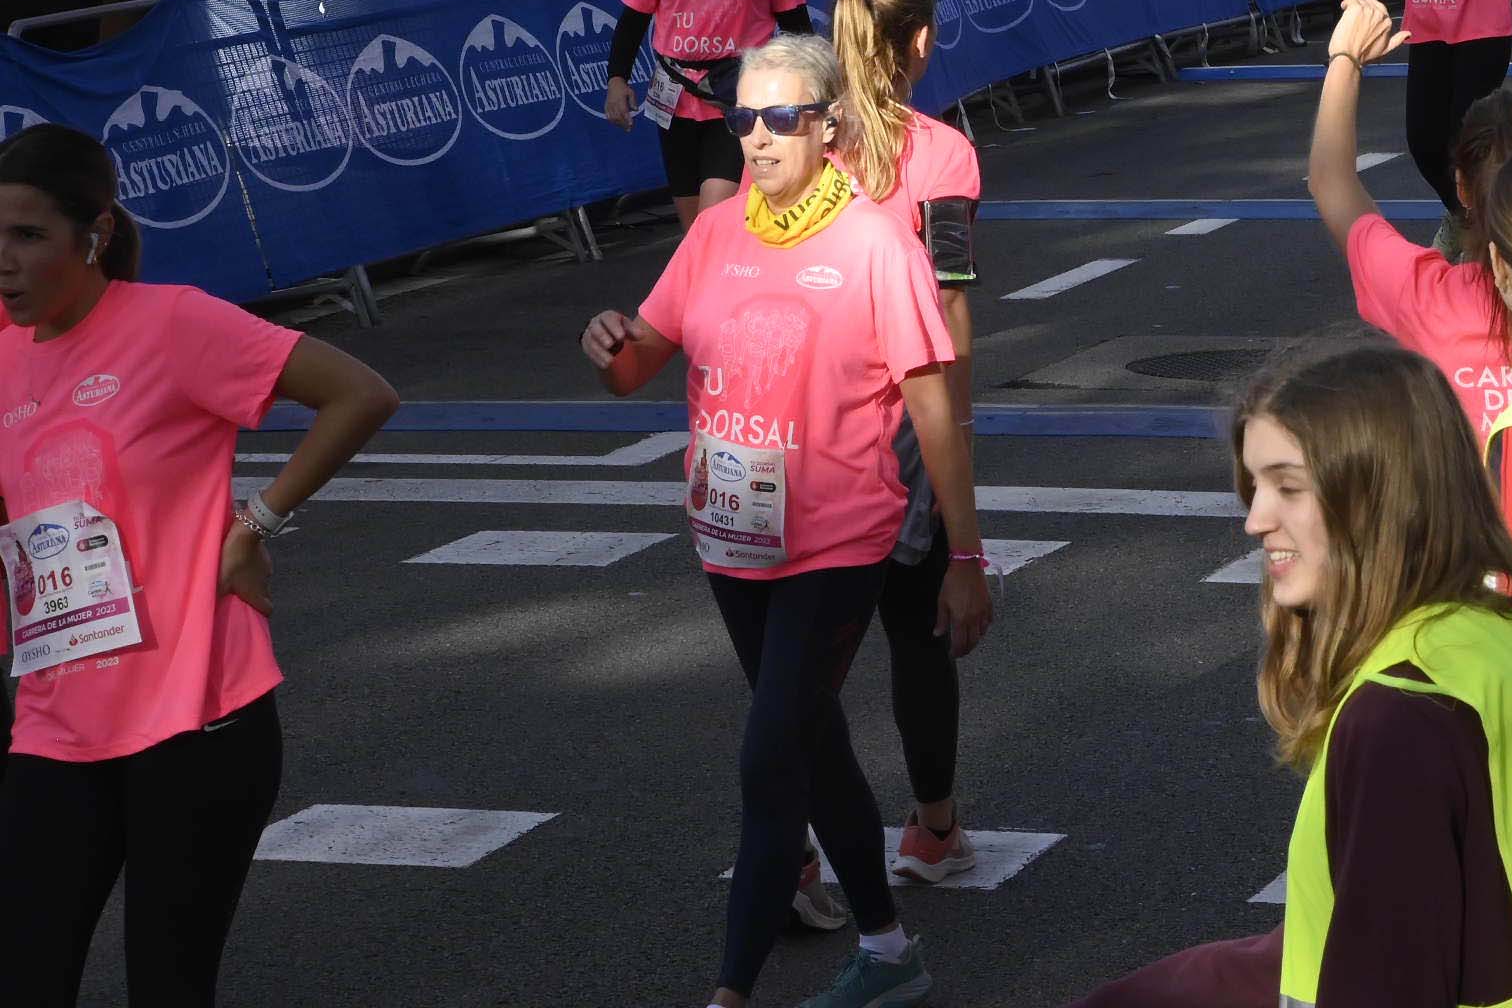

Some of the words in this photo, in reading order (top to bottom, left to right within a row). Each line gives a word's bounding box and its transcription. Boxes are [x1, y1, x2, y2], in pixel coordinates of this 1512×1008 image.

[673, 11, 694, 29] TU
[672, 35, 736, 54] DORSA
[479, 58, 511, 73] CENTRAL
[512, 54, 546, 68] LECHERA
[565, 50, 650, 95] ASTUNA
[469, 66, 561, 113] ASTURIANA
[357, 89, 458, 139] ASTURIANA
[113, 140, 224, 201] ASTURIANA
[722, 263, 760, 279] YSHO
[699, 365, 724, 395] TU
[696, 408, 799, 450] DORSAL
[749, 464, 775, 474] SUMA
[709, 488, 740, 511] 016
[710, 512, 735, 527] 10431
[719, 528, 727, 537] LA
[728, 532, 752, 543] MUJER
[38, 566, 73, 595] 016
[44, 596, 69, 614] 3963
[47, 619, 57, 630] DE
[58, 617, 67, 628] LA
[67, 611, 92, 626] MUJER
[96, 605, 117, 616] 2023
[78, 624, 126, 645] Santander
[96, 656, 120, 669] 2023
